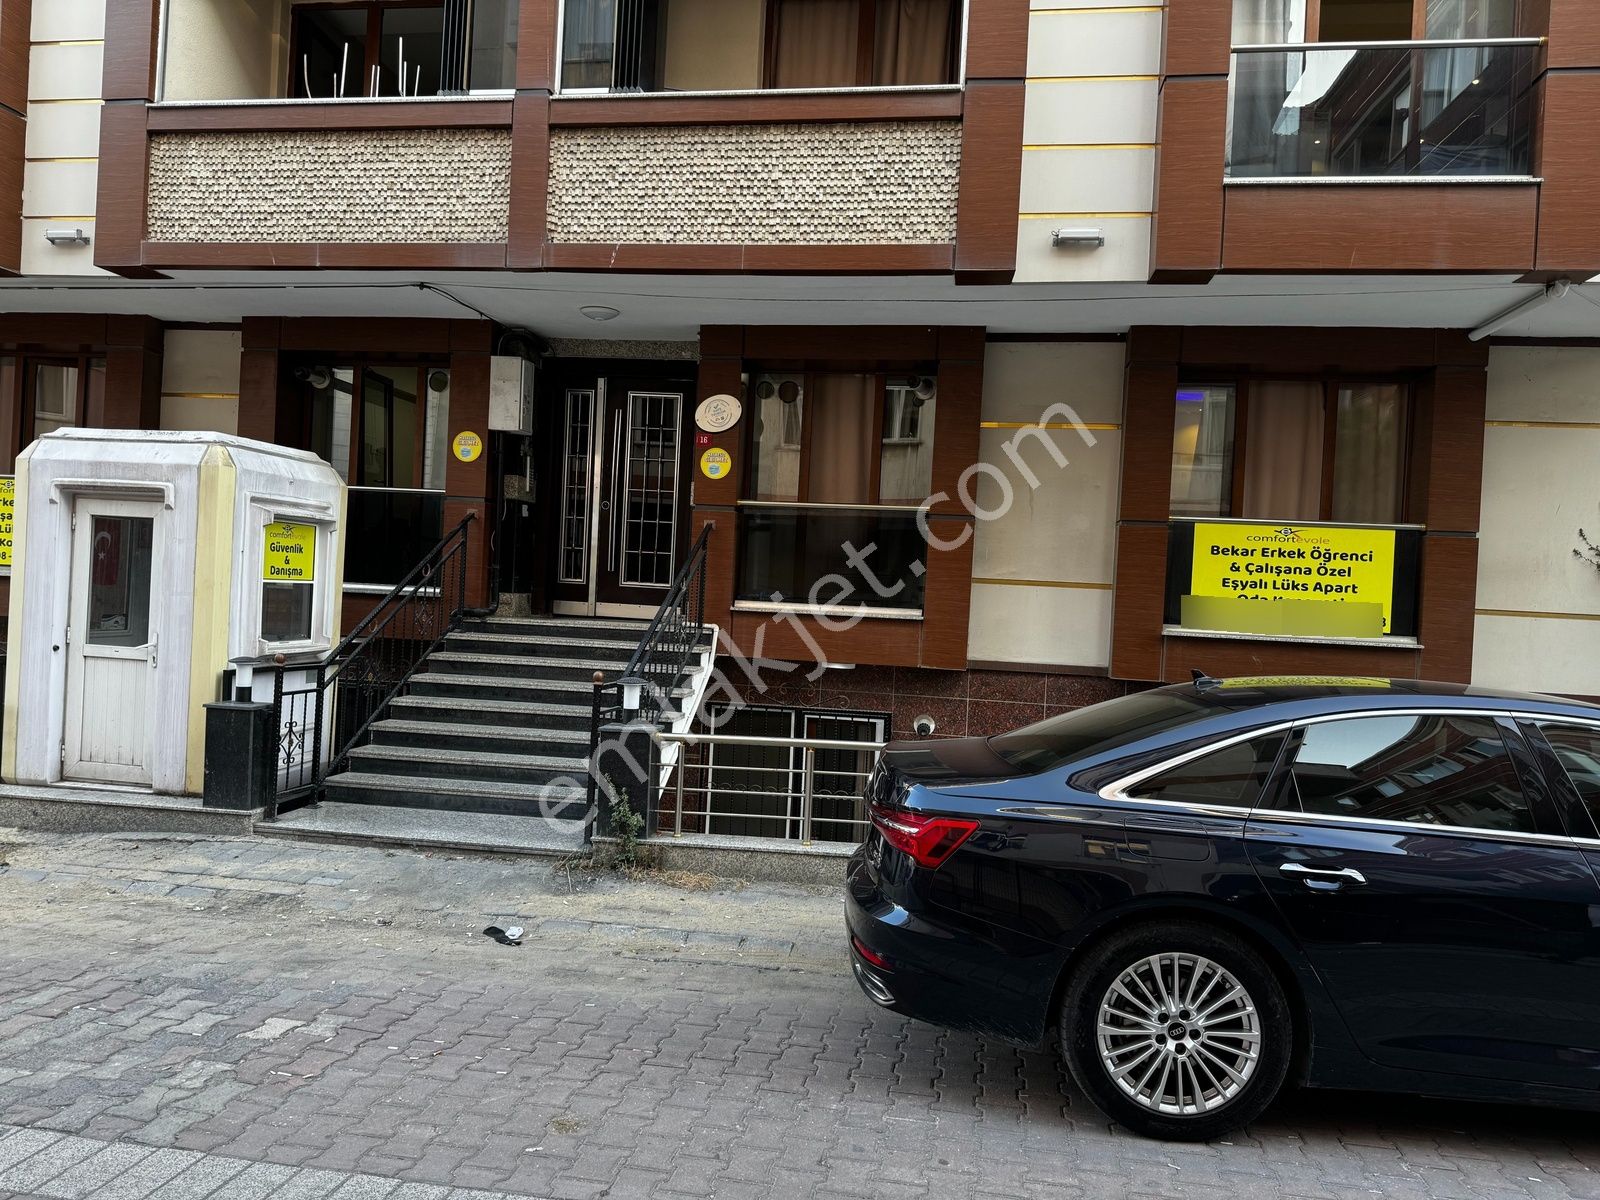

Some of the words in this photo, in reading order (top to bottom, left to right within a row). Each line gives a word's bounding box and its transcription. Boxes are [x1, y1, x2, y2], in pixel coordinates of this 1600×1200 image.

[700, 436, 708, 444] 16
[1246, 534, 1330, 545] comfortevole
[269, 541, 304, 554] Güvenlik
[1210, 545, 1257, 558] Bekar
[1261, 546, 1306, 559] Erkek
[1310, 546, 1373, 562] Öğrenci
[284, 555, 290, 565] &
[270, 565, 303, 578] Danışma
[1229, 562, 1241, 573] &
[1245, 562, 1312, 577] Çalışana
[1316, 563, 1352, 578] Özel
[1221, 577, 1268, 591] Eşyalı
[1272, 578, 1309, 592] Lüks
[1313, 581, 1358, 595] Apart
